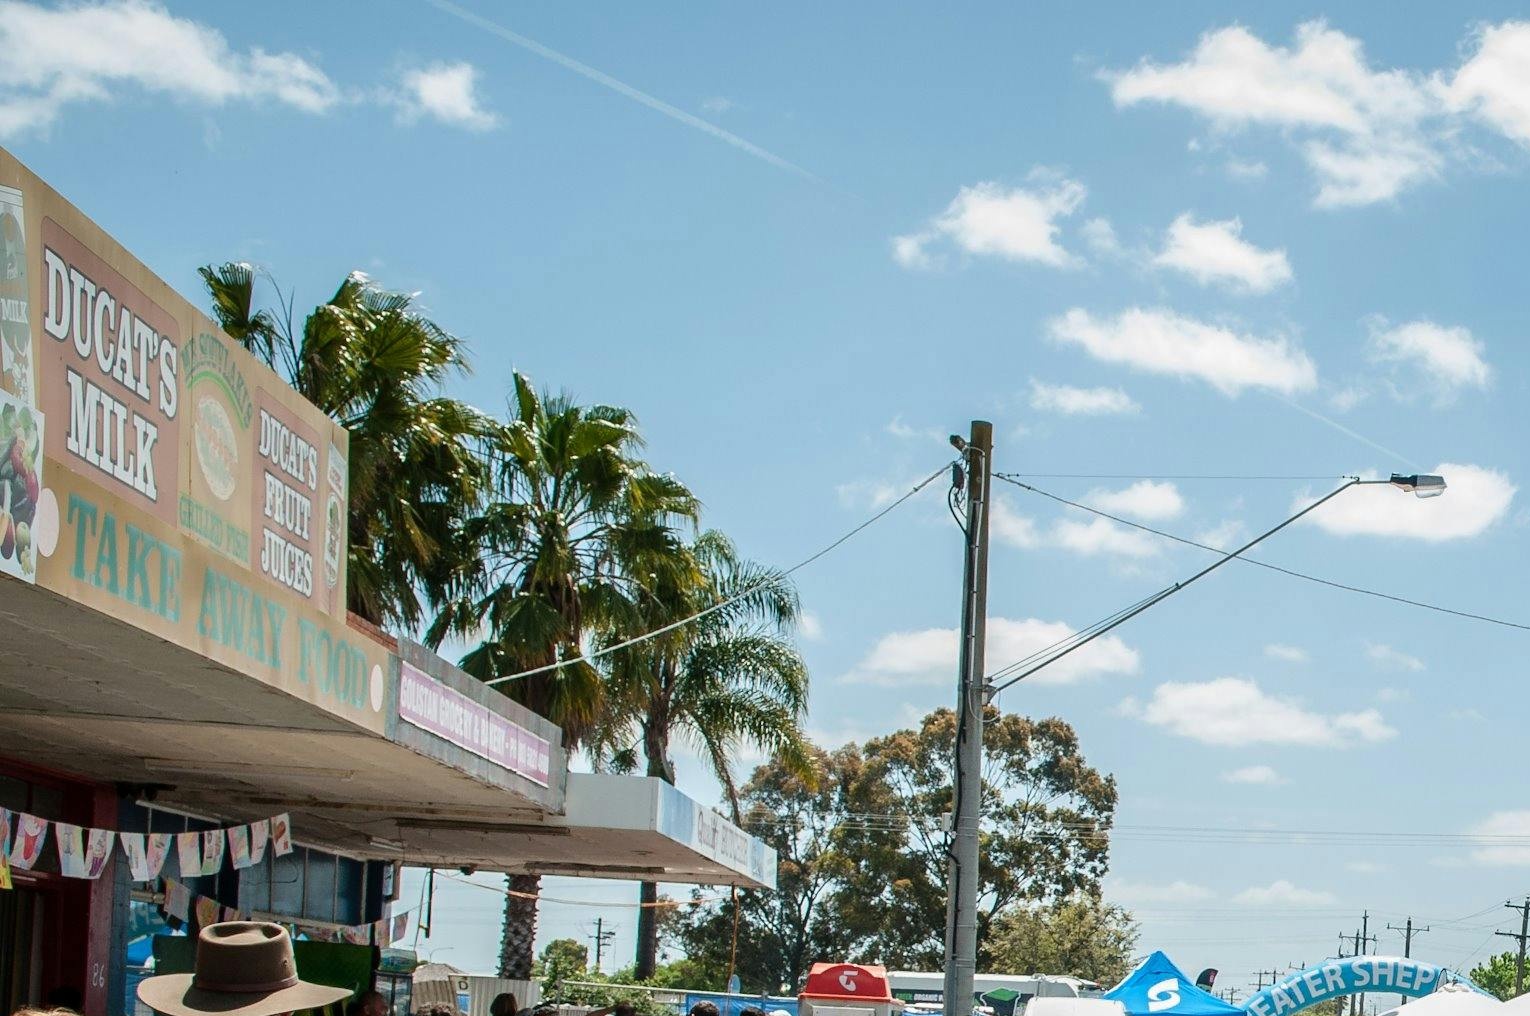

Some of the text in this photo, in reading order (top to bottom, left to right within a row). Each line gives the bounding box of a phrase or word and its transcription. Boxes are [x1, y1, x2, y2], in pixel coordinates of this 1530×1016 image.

[44, 247, 178, 420] DUCAT'S
[66, 367, 158, 503] MILK
[259, 408, 317, 491] DUCAT'S
[264, 470, 311, 541] FRUIT
[67, 493, 368, 709] TAKE AWAY FOOD
[261, 527, 312, 598] JUICES
[440, 696, 473, 740] GROCERY
[1354, 960, 1436, 991] SHEP
